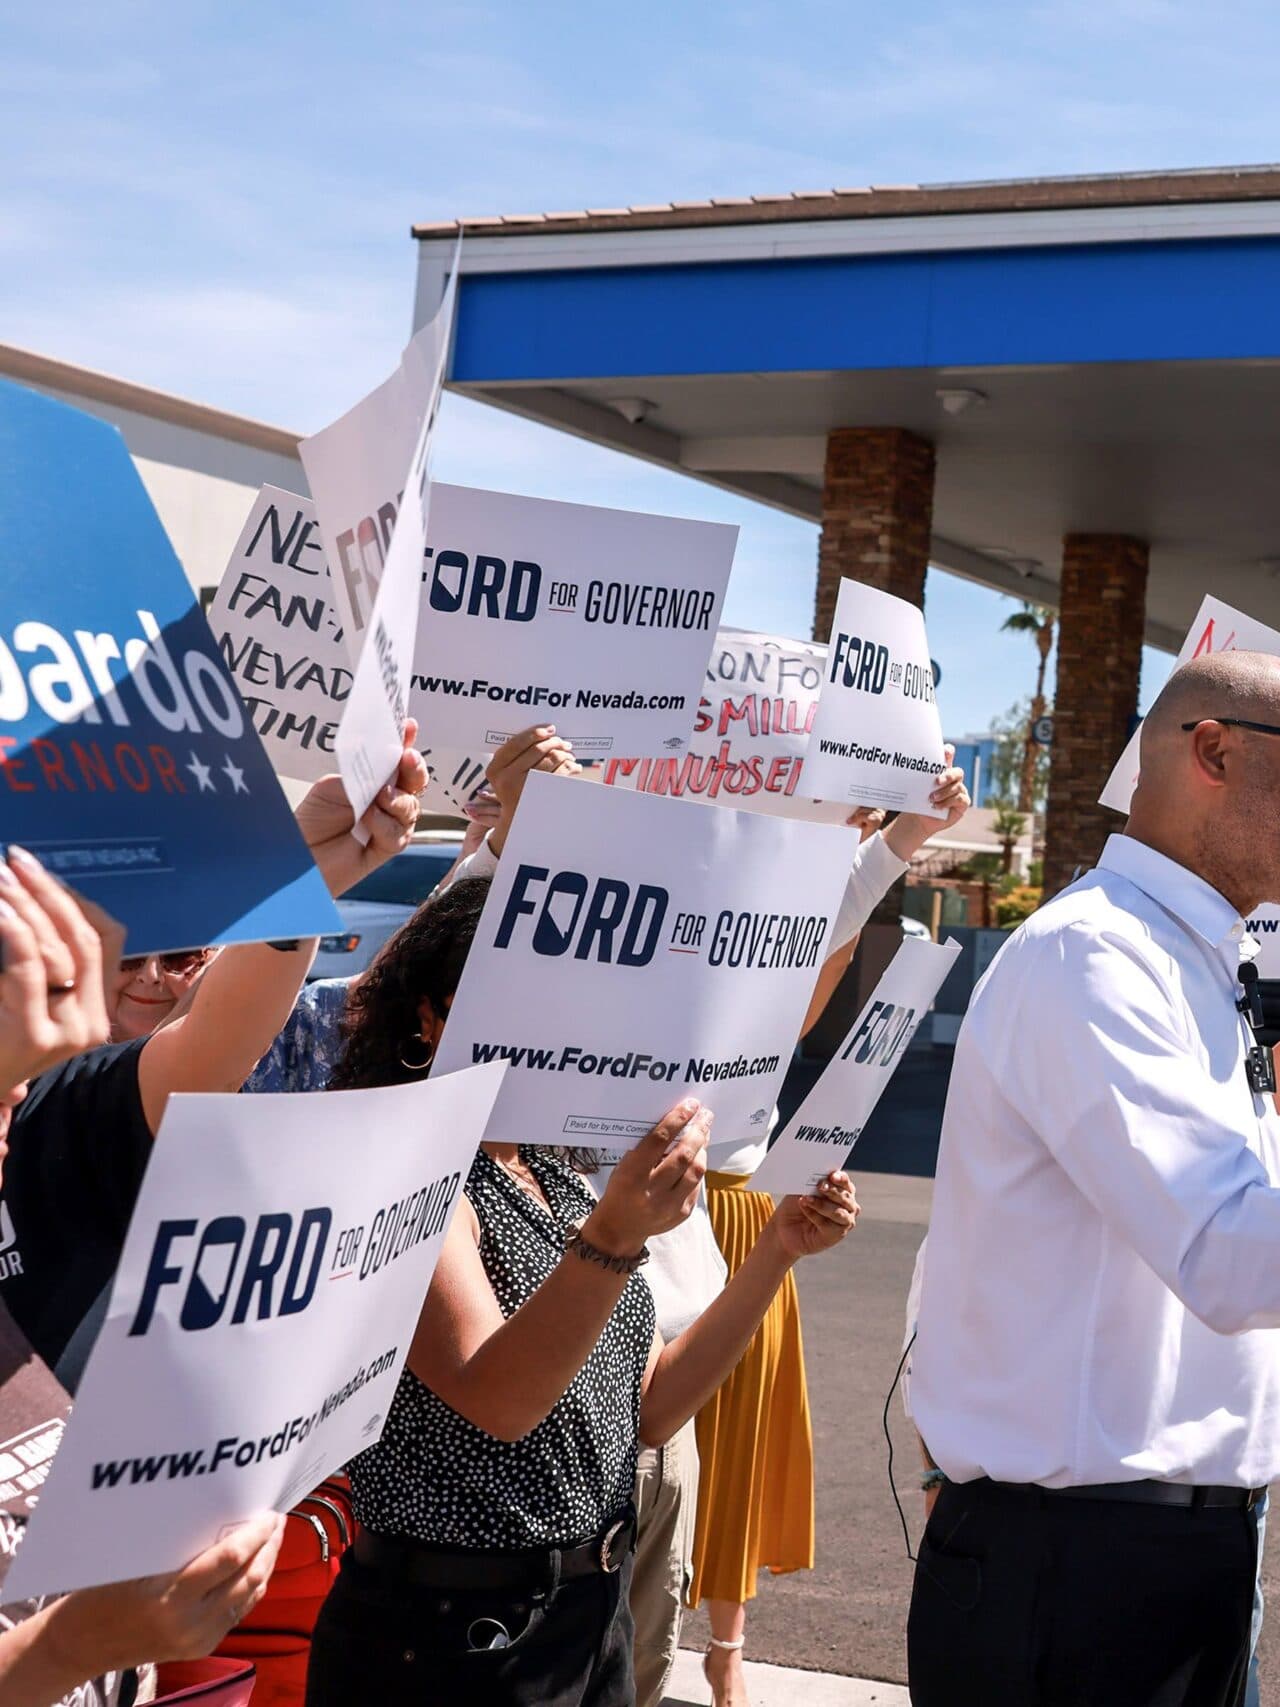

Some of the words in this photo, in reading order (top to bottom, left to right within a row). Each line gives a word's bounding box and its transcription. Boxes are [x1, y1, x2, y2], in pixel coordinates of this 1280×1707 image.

[245, 504, 331, 577] NE
[228, 572, 343, 642] FAN
[549, 582, 578, 607] FOR
[585, 580, 715, 631] GOVERNOR
[219, 632, 354, 701] NEVAD
[706, 651, 770, 682] ON
[777, 657, 820, 694] FO
[830, 633, 888, 695] FORD
[890, 662, 902, 683] FOR
[576, 690, 685, 709] Nevada.com
[820, 738, 892, 766] www.FordFor
[494, 864, 669, 967] FORD
[671, 913, 706, 946] FOR
[708, 910, 828, 968] GOVERNOR
[471, 1042, 680, 1083] www.FordFor
[684, 1054, 780, 1083] Nevada.com
[841, 1001, 915, 1067] FORD
[570, 1120, 587, 1129] Paid
[626, 1125, 650, 1133] Comm
[795, 1125, 860, 1146] www.FordF
[128, 1207, 332, 1337] FORD
[332, 1226, 364, 1270] FOR
[359, 1171, 461, 1281] GOVERNOR
[90, 1415, 319, 1490] www.FordFor
[316, 1347, 397, 1424] Nevada.com
